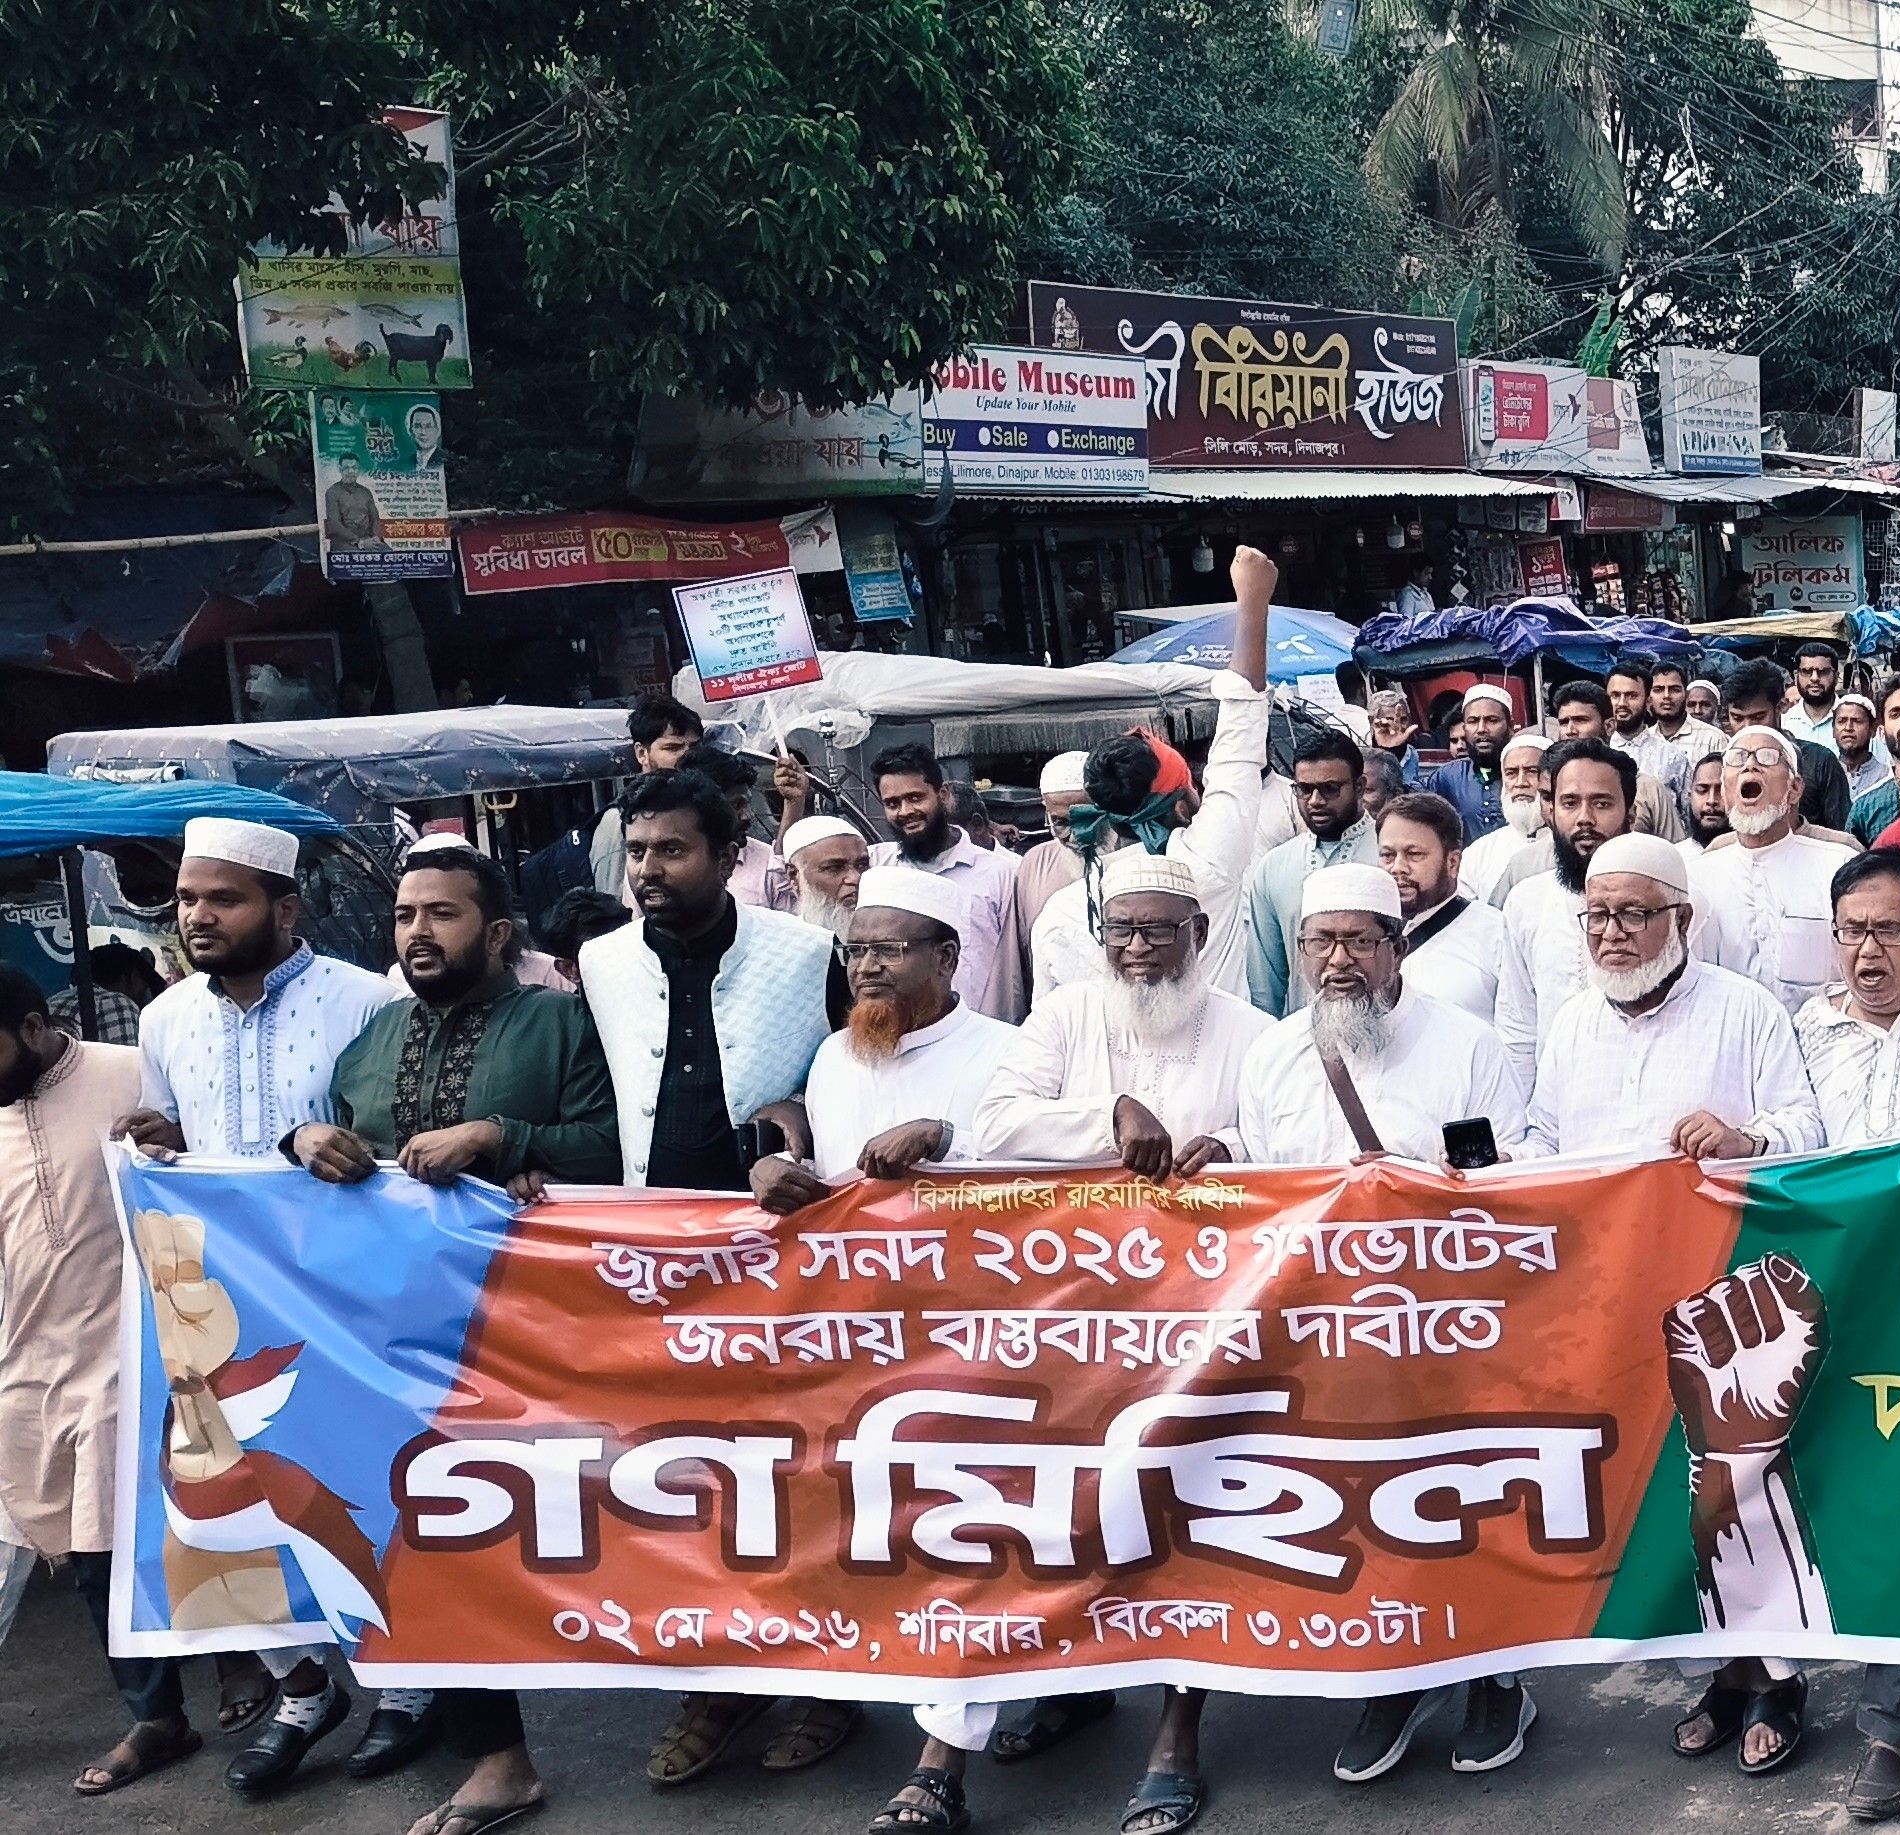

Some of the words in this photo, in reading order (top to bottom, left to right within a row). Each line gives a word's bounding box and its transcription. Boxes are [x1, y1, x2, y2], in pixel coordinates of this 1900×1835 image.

[937, 352, 1007, 393] obile
[1017, 360, 1136, 400] Museum
[1191, 322, 1352, 430] বিরিয়ানী
[1354, 327, 1445, 440] হাউজ
[976, 396, 1013, 412] Update
[1016, 397, 1040, 411] Your
[1043, 399, 1077, 413] Mobile
[923, 425, 956, 450] Buy
[992, 426, 1028, 447] Sale
[1061, 429, 1136, 455] Exchange
[471, 548, 532, 577] সুবিধা
[533, 544, 588, 571] ডাবল
[913, 1178, 1058, 1214] বিসমিল্লাহির
[1065, 1177, 1172, 1211] রাহমানির
[1174, 1178, 1246, 1212] রাহীম
[592, 1231, 782, 1306] জুলাই
[798, 1227, 947, 1286] সনদ
[972, 1220, 1167, 1287] ২০২৫
[1196, 1223, 1232, 1279] ও
[1251, 1208, 1559, 1279] গণভোটের
[662, 1308, 907, 1370] জনরায়
[922, 1305, 1263, 1371] বাস্তবায়নের
[1280, 1279, 1506, 1365] দাবীতে
[402, 1422, 793, 1562] গণ
[836, 1389, 1604, 1579] মিছিল
[552, 1600, 640, 1657] ০২
[653, 1605, 704, 1653] মে
[1084, 1597, 1229, 1645] বিকেল
